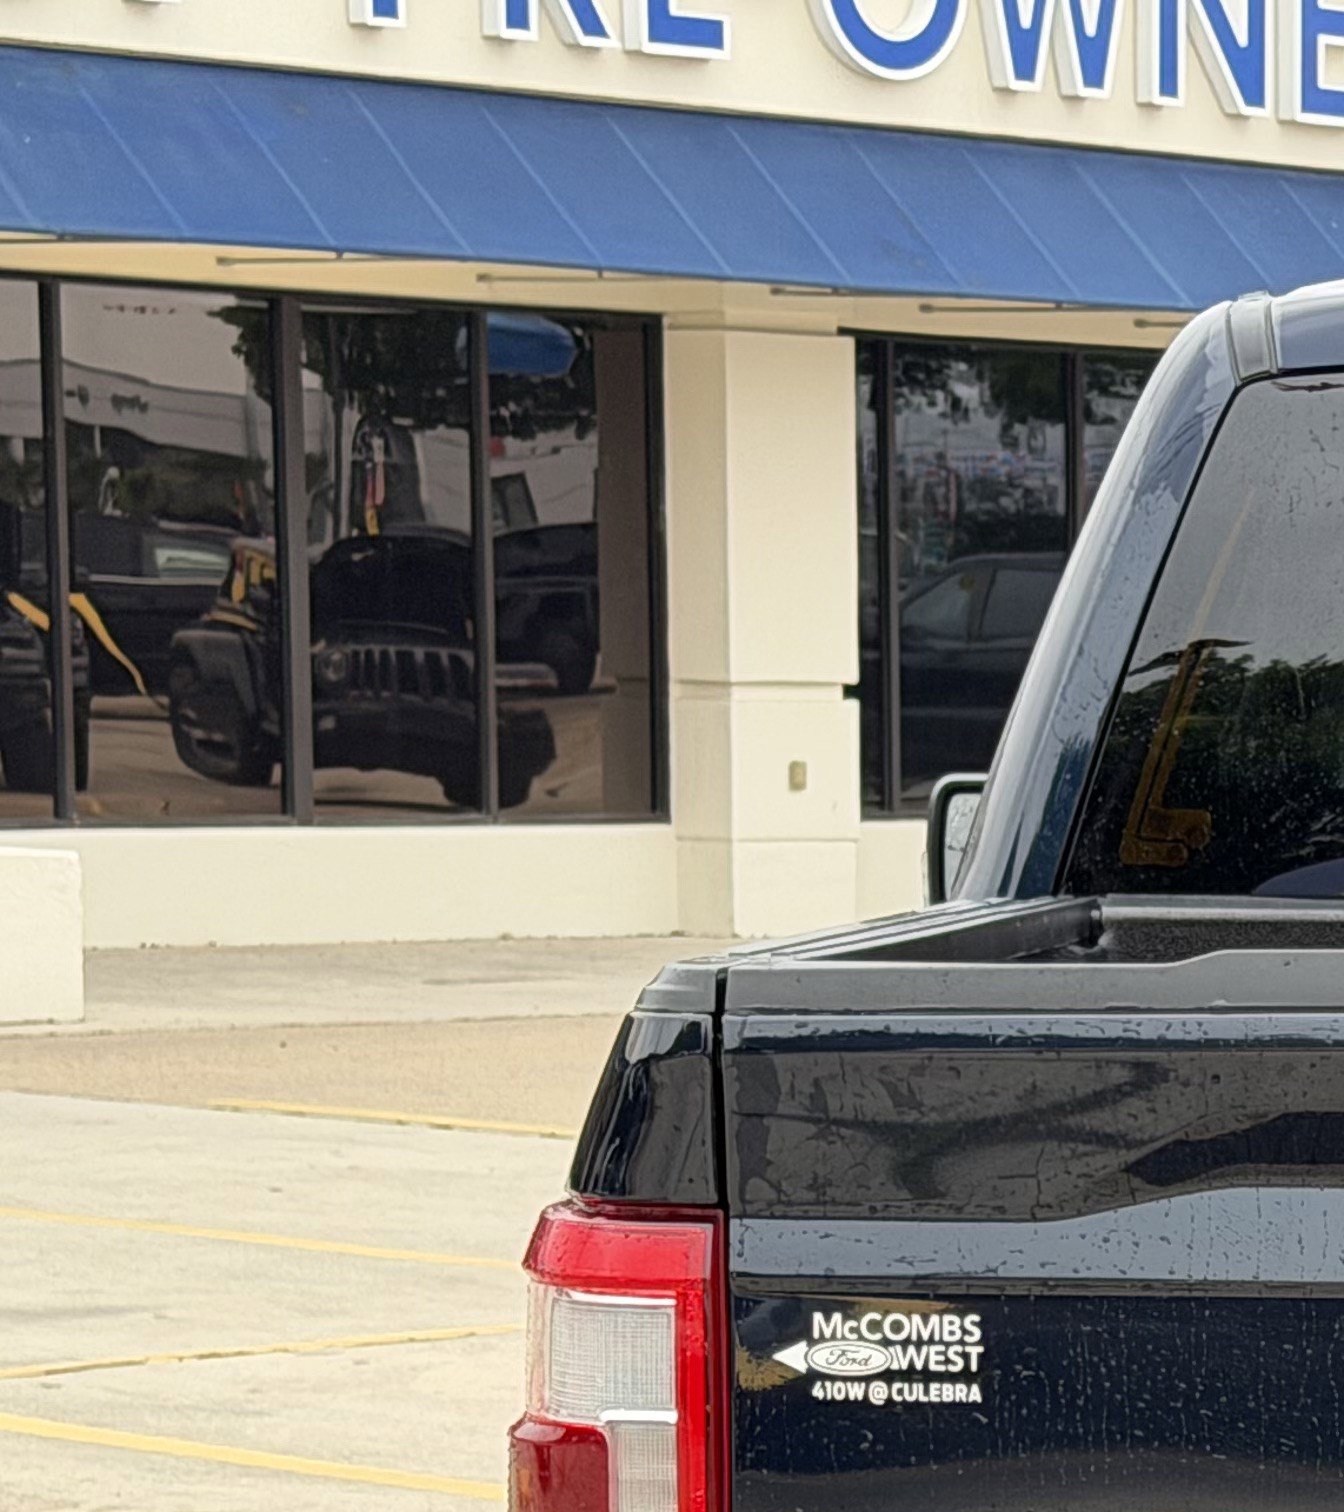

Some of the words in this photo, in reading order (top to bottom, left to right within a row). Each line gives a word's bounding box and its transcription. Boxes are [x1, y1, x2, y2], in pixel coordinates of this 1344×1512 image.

[811, 1311, 983, 1343] McCOMBS
[824, 1348, 874, 1368] Ford
[896, 1344, 985, 1373] WEST
[891, 1383, 983, 1404] CULEBRA
